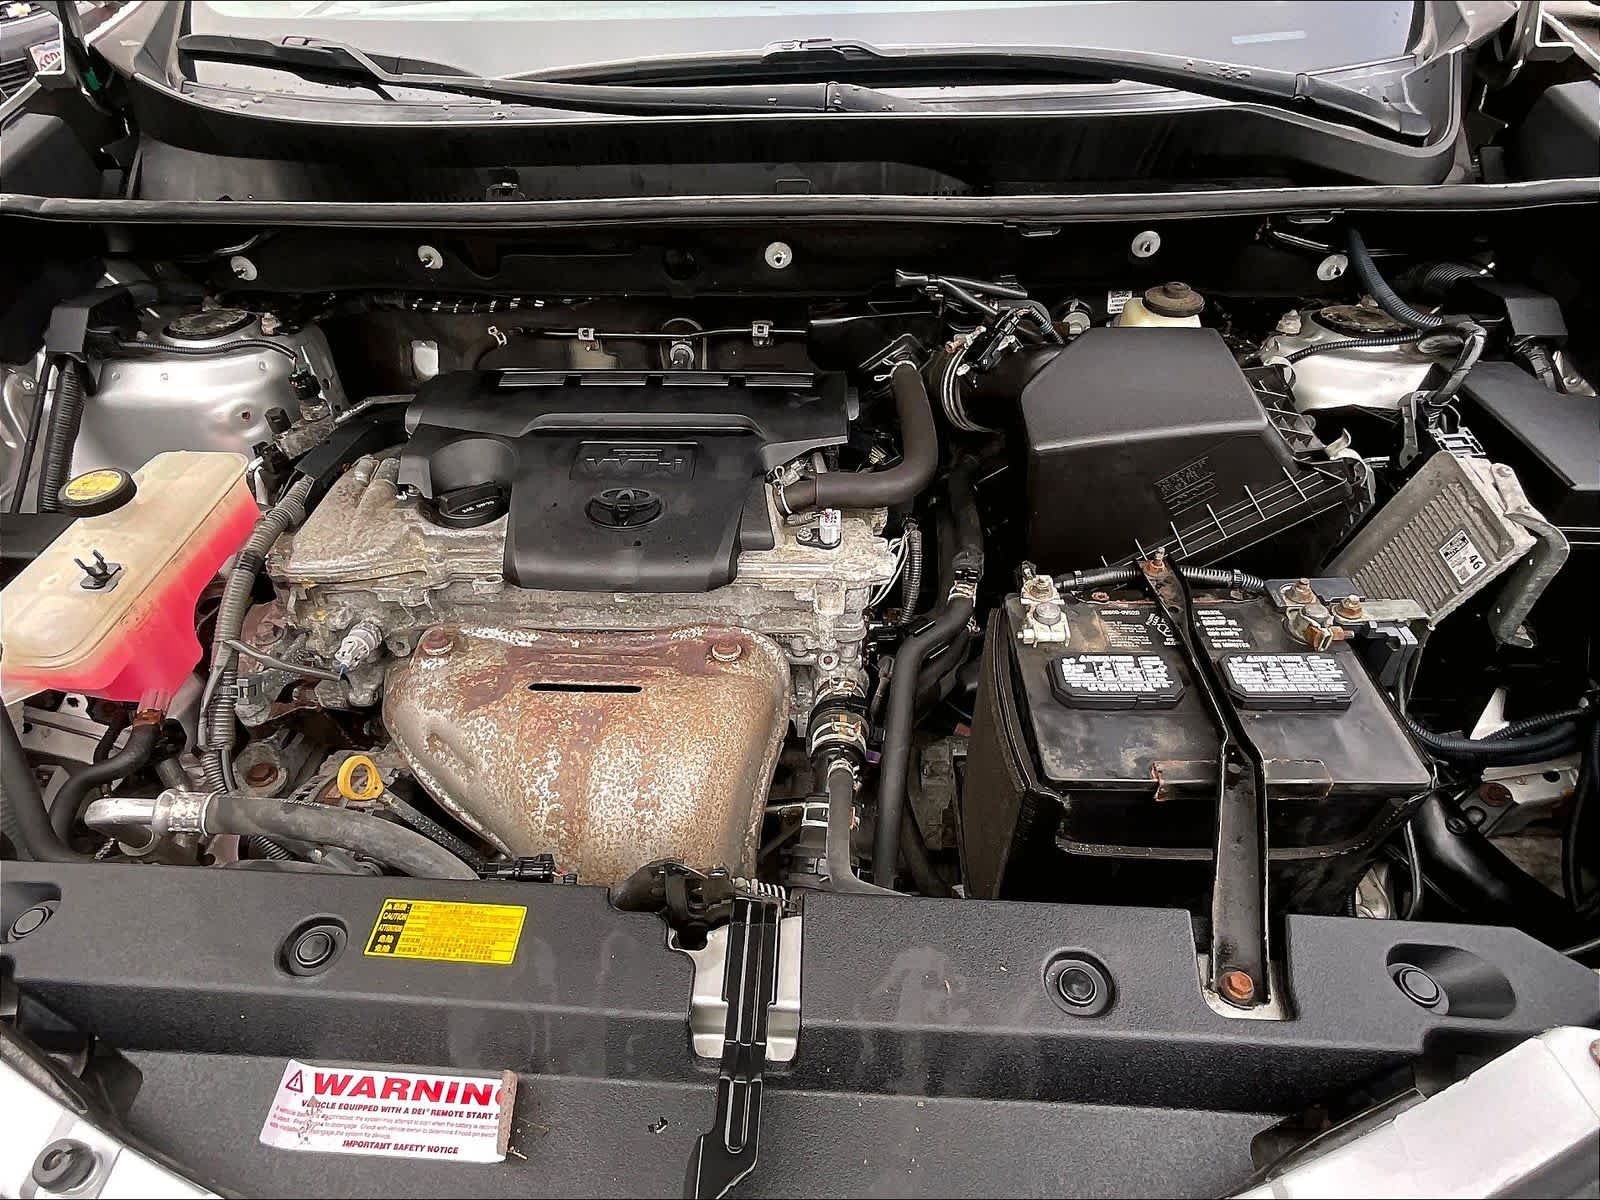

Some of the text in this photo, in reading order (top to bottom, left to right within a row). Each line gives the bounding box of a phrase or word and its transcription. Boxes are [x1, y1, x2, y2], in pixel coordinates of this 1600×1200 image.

[1469, 554, 1483, 570] 46
[382, 912, 408, 921] CAUTION
[338, 1102, 379, 1112] EQUIPPED
[381, 1106, 402, 1114] WITH
[431, 1109, 464, 1118] REMOTE
[466, 1111, 493, 1119] START
[342, 1140, 458, 1154] IMPORTANT SAFETY NOTICE
